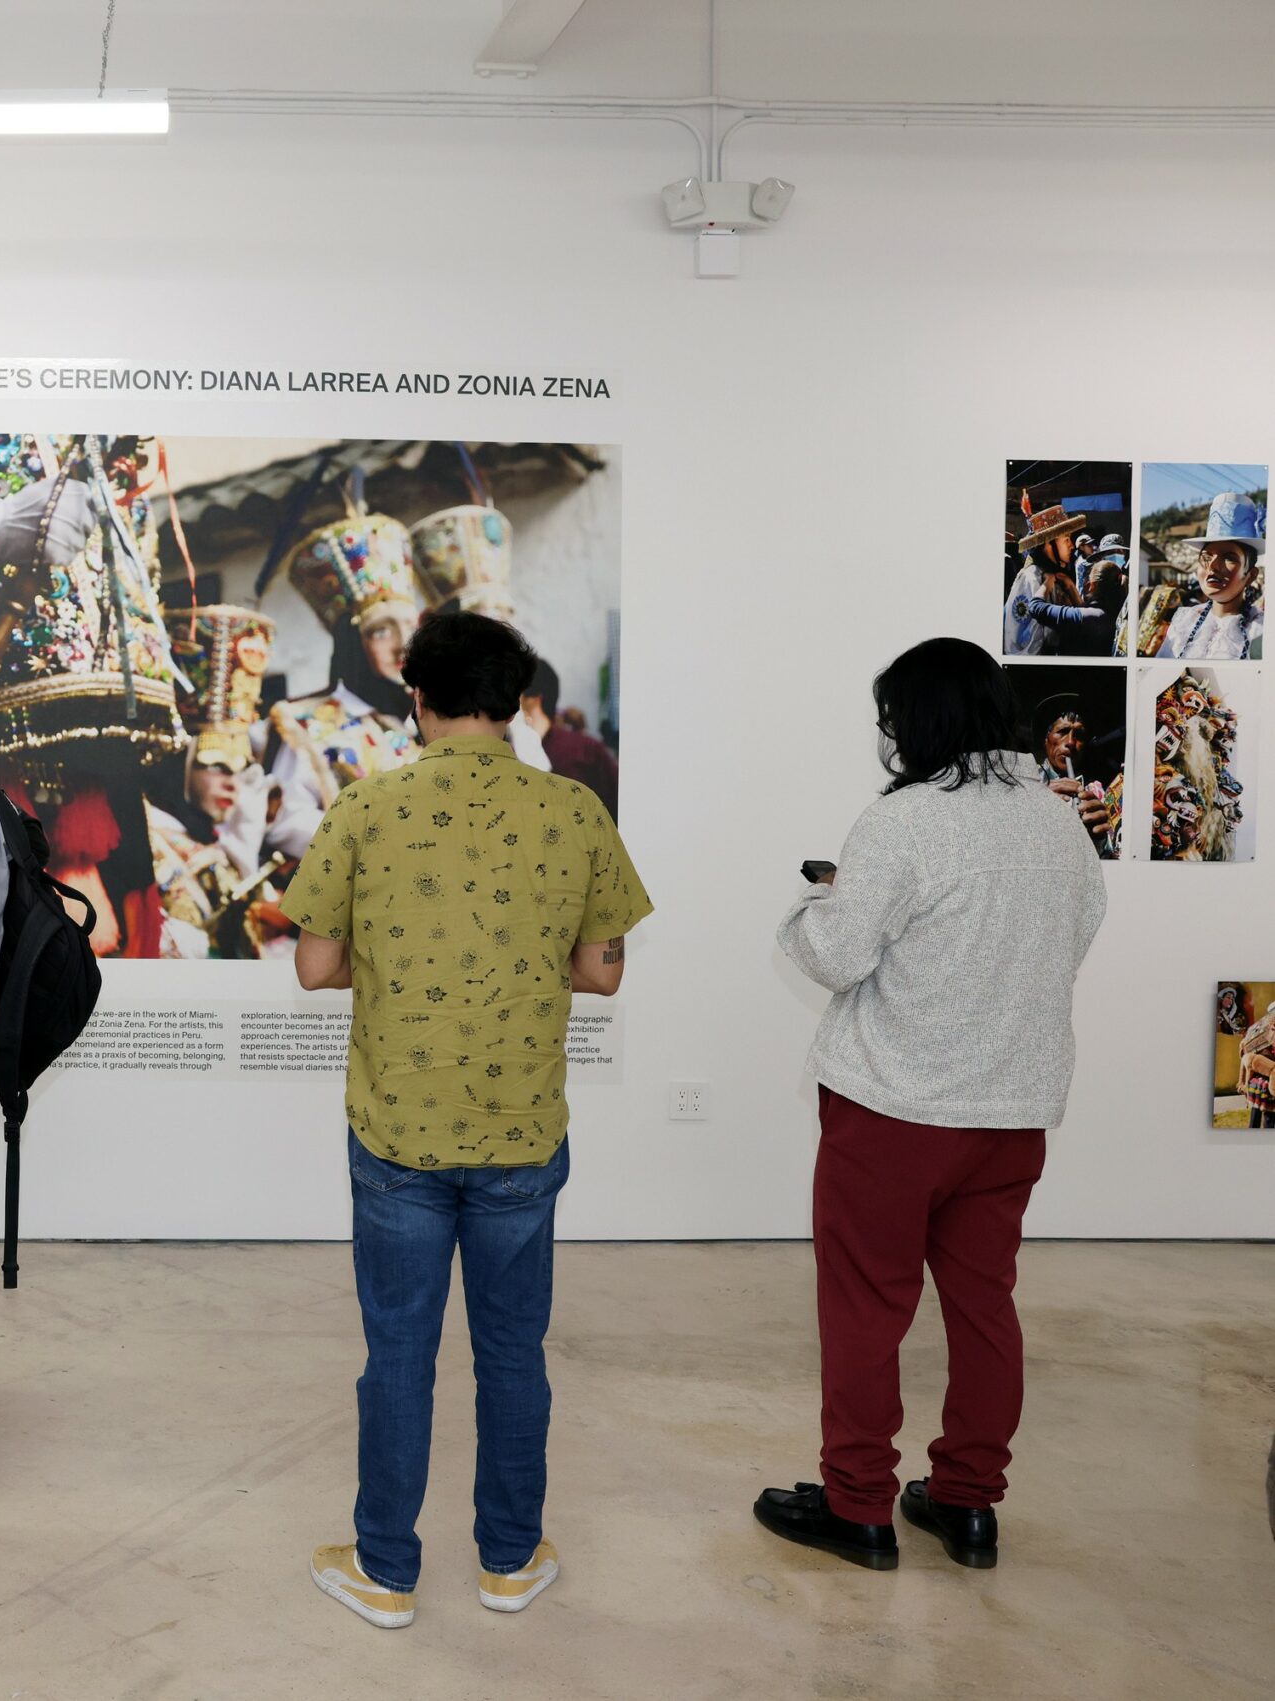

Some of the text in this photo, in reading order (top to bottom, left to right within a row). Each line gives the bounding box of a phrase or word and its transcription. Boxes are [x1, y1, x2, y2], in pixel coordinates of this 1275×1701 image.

[40, 368, 193, 391] CEREMONY:
[201, 370, 280, 391] DIANA
[288, 371, 389, 393] LARREA
[395, 373, 450, 394] AND
[457, 375, 536, 396] ZONIA
[542, 378, 611, 399] ZENA
[133, 1010, 140, 1018] in
[189, 1011, 217, 1019] Miami-
[241, 1011, 288, 1021] exploration,
[290, 1012, 325, 1022] learning,
[99, 1020, 122, 1028] Zonia
[124, 1020, 147, 1028] Zena.
[164, 1021, 177, 1029] the
[179, 1021, 207, 1030] artists,
[241, 1022, 282, 1030] encounter
[285, 1023, 323, 1031] becomes
[85, 1030, 131, 1039] ceremonial
[133, 1031, 171, 1041] practices
[173, 1031, 179, 1039] in
[182, 1032, 203, 1040] Peru.
[241, 1032, 279, 1041] approach
[281, 1033, 329, 1041] ceremonies
[74, 1041, 115, 1049] homeland
[133, 1041, 184, 1051] experienced
[205, 1042, 224, 1050] form
[241, 1043, 292, 1052] experiences.
[295, 1042, 310, 1051] The
[312, 1043, 337, 1051] artists
[567, 1046, 601, 1054] practice
[102, 1052, 126, 1061] praxis
[138, 1052, 181, 1062] becoming,
[183, 1052, 226, 1063] belonging,
[258, 1053, 284, 1061] resists
[287, 1053, 326, 1062] spectacle
[328, 1053, 343, 1061] and
[597, 1056, 613, 1064] that
[65, 1061, 101, 1071] practice,
[103, 1061, 107, 1069] it
[109, 1061, 147, 1071] gradually
[149, 1062, 178, 1070] reveals
[180, 1062, 212, 1072] through
[240, 1063, 278, 1071] resemble
[280, 1063, 303, 1071] visual
[305, 1063, 333, 1072] diaries
